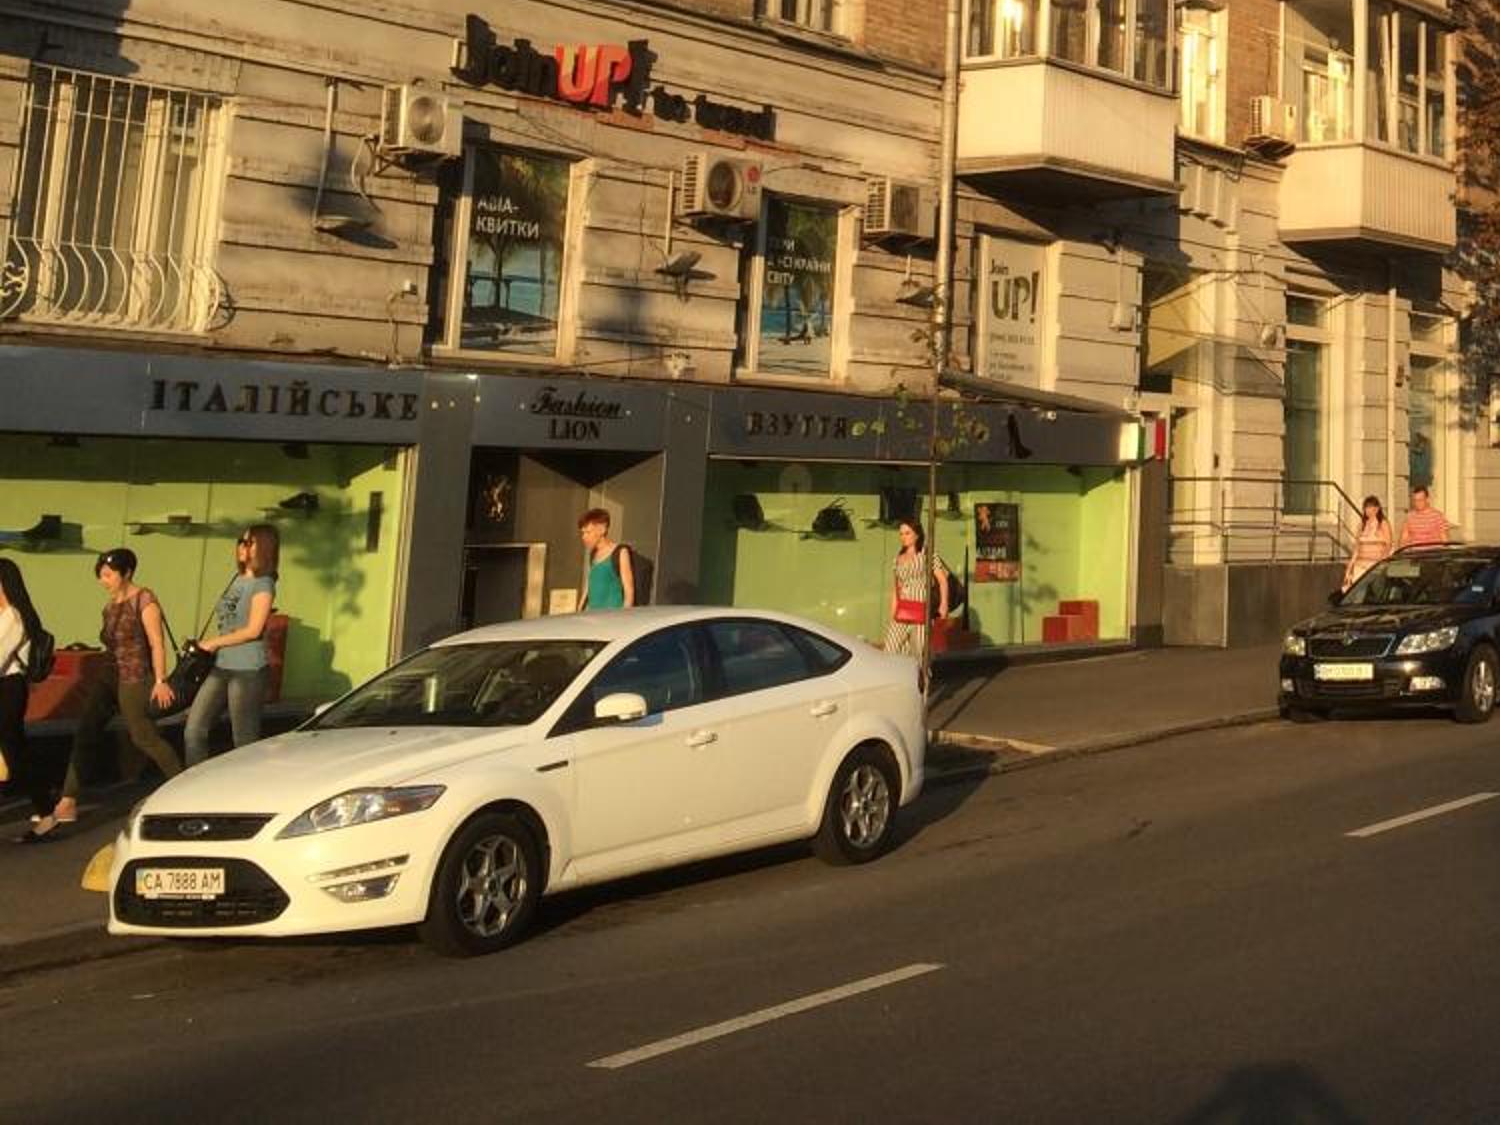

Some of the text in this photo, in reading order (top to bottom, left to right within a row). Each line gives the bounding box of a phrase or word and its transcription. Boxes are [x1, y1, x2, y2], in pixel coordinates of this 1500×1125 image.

[475, 215, 540, 240] КВИТКИ
[991, 271, 1040, 324] UP!
[149, 379, 418, 421] ІТАЛІЙСЬКЕ
[529, 386, 624, 418] Fashion
[549, 418, 602, 441] LION
[746, 412, 848, 439] ВЗУТТЯ
[143, 873, 163, 890] CA
[201, 872, 221, 890] AM
